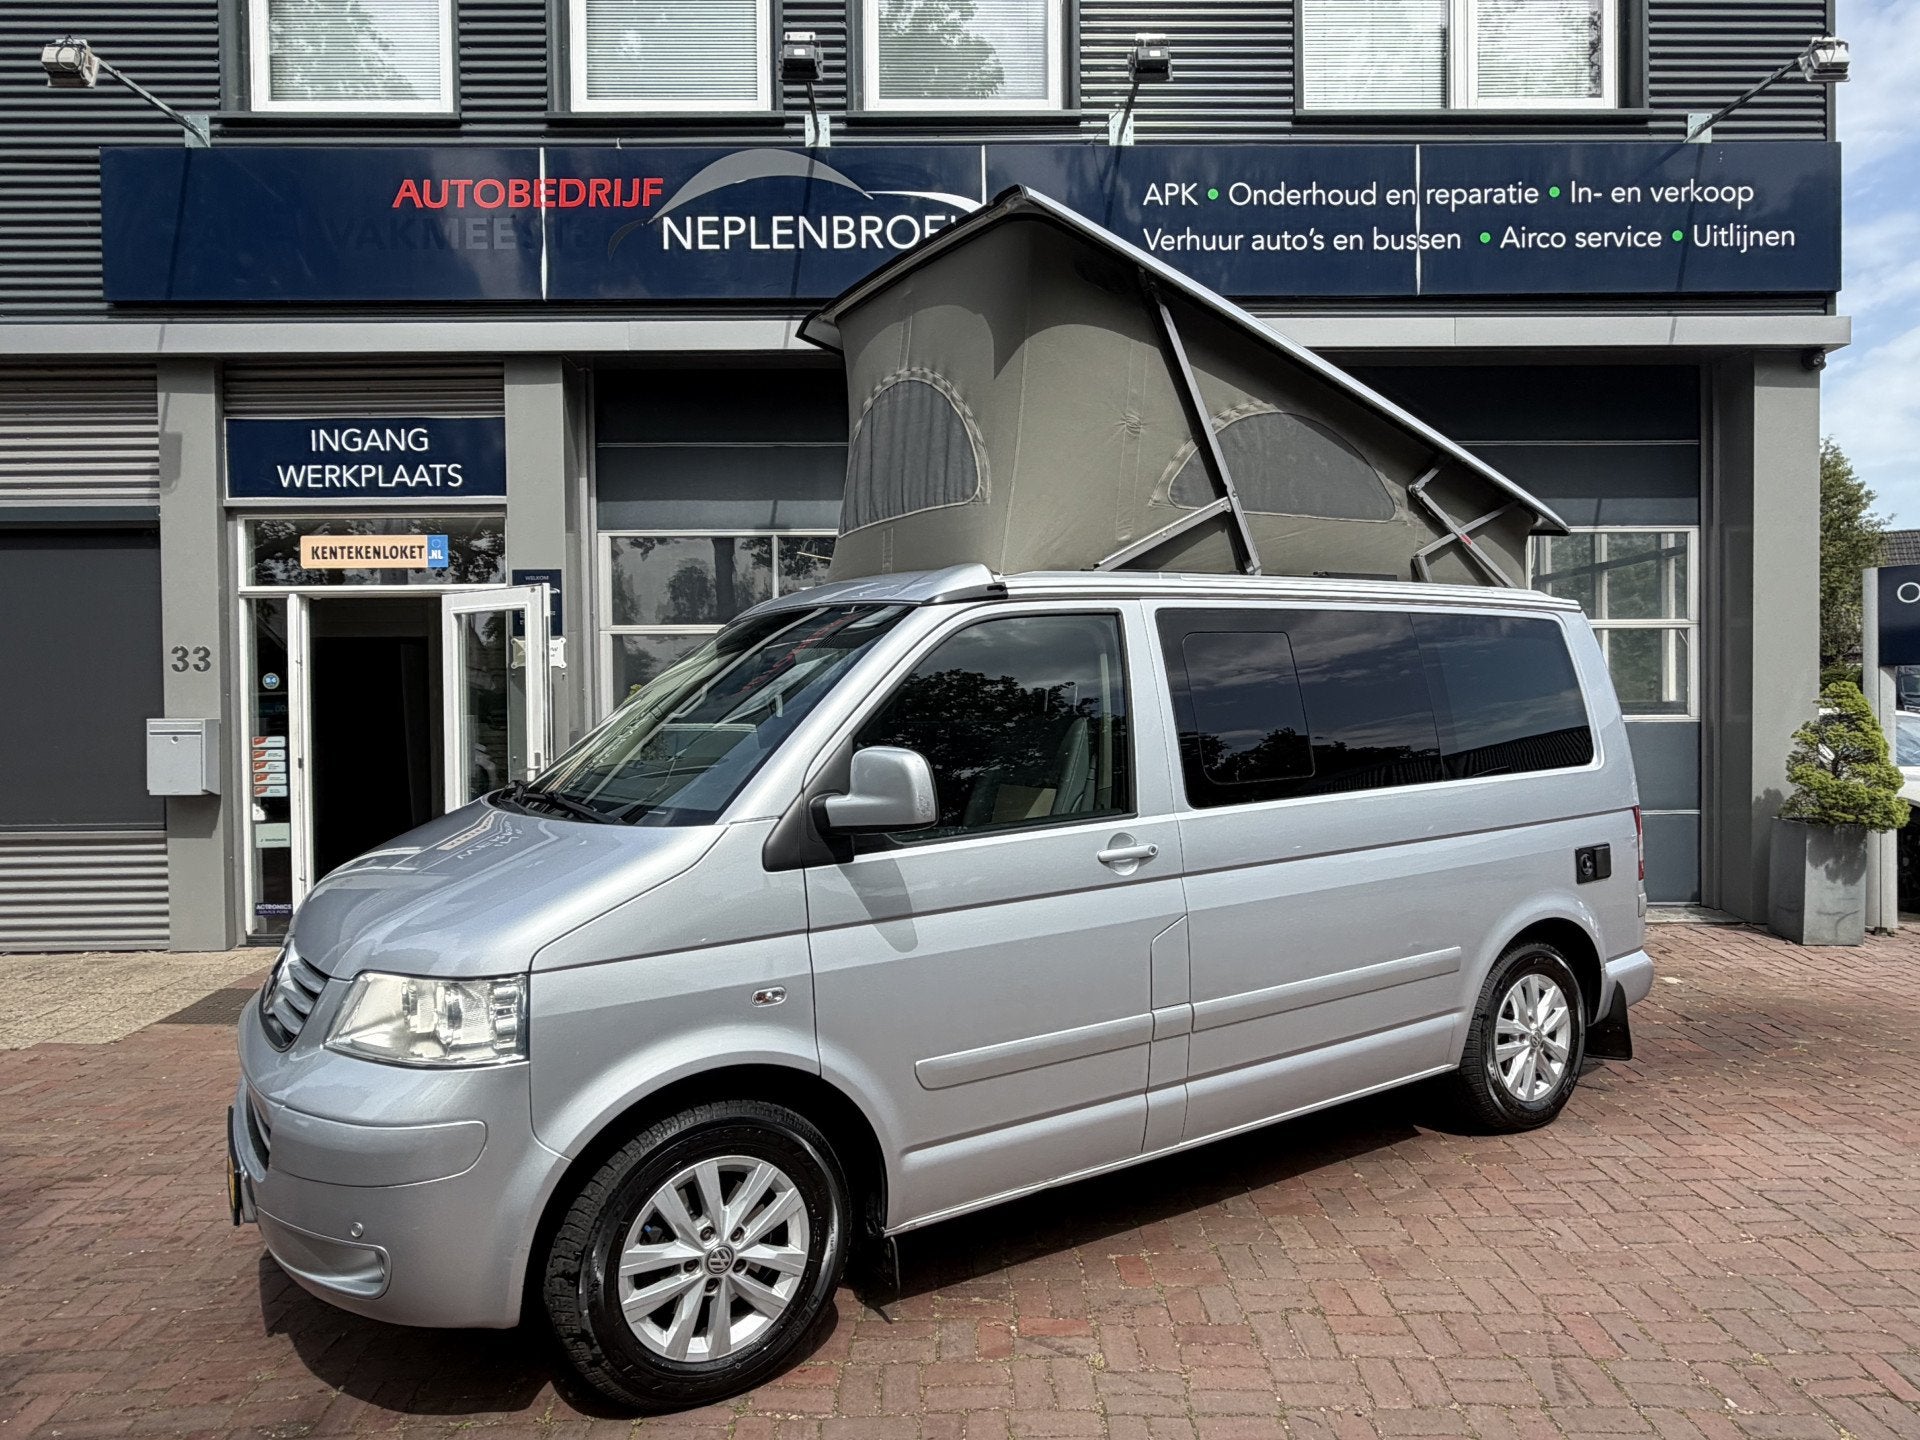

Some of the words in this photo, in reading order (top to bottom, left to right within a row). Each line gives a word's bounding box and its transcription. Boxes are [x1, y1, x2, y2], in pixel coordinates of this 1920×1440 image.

[393, 178, 663, 208] AUTOBEDRIJF
[1142, 182, 1199, 206] APK
[1228, 180, 1377, 206] Onderhoud
[1385, 188, 1416, 206] en
[1425, 181, 1540, 213] reparatie
[1570, 180, 1604, 204] In-
[1610, 186, 1642, 203] en
[1649, 178, 1755, 211] verkoop
[661, 214, 957, 250] NEPLENBROE
[1142, 226, 1244, 251] Verhuur
[1251, 227, 1326, 251] auto's
[1332, 234, 1364, 251] en
[1373, 226, 1462, 251] bussen
[1499, 225, 1568, 249] Airco
[1574, 225, 1663, 248] service
[1693, 222, 1796, 254] Uitlijnen
[310, 427, 430, 452] INGANG
[276, 463, 464, 488] WERKPLAATS
[311, 545, 425, 560] KENTEKENLOKET
[171, 645, 212, 673] 33
